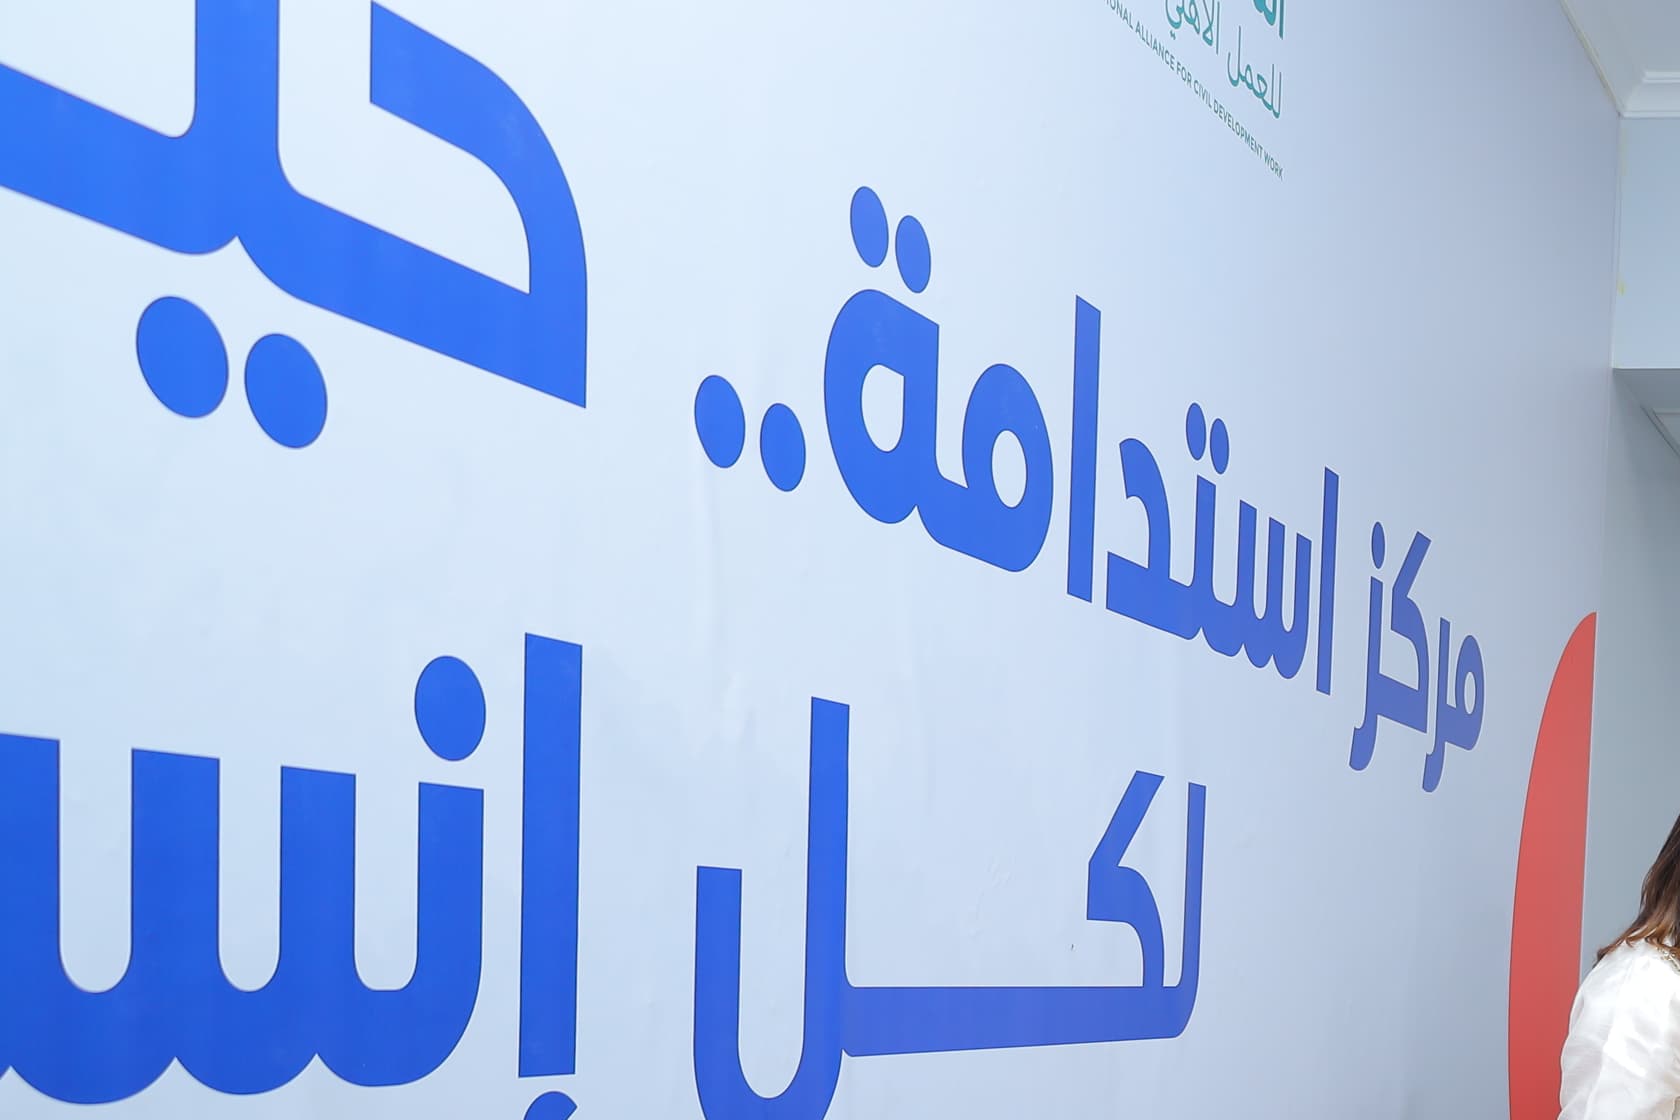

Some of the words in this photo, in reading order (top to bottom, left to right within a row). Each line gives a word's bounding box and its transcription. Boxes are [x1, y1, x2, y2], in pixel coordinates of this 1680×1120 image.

[1106, 0, 1133, 30] ONAL
[1135, 20, 1175, 71] ALLIANCE
[1177, 61, 1192, 88] FOR
[1193, 79, 1212, 109] CIVIL
[1213, 99, 1263, 159] DEVELOPMENT
[1264, 150, 1284, 181] WORK
[1227, 25, 1282, 119] للعمل
[1349, 521, 1485, 793] مركز
